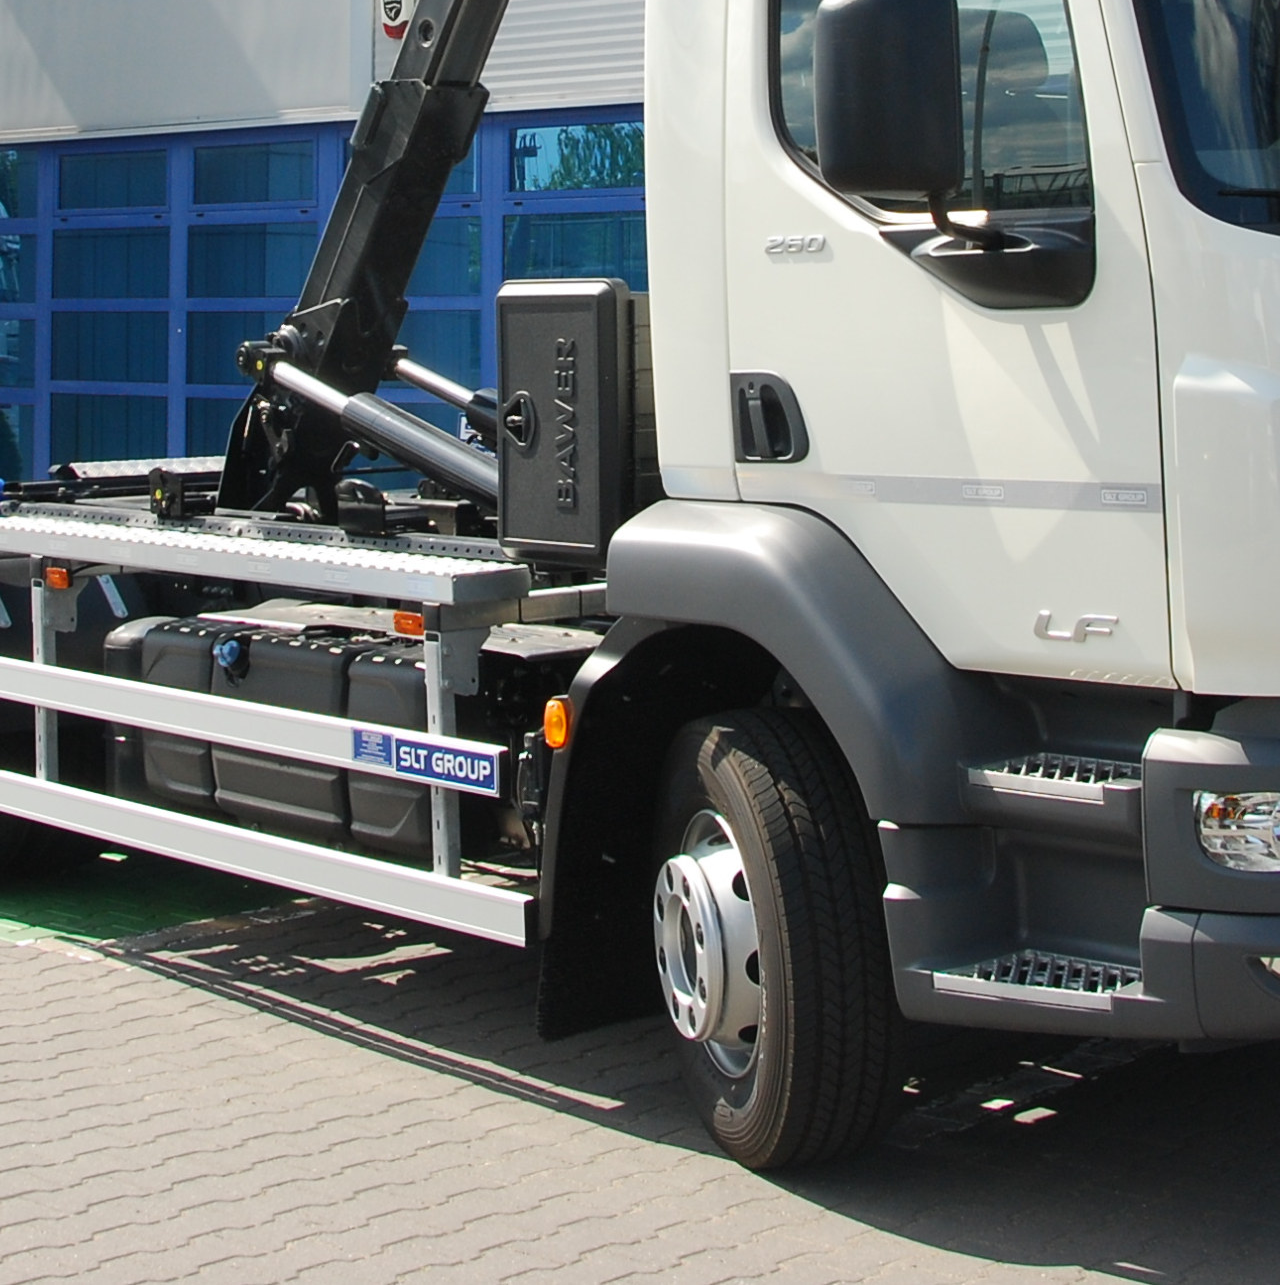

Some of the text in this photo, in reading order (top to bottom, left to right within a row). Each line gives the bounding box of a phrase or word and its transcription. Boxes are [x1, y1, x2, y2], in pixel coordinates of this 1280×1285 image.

[765, 234, 826, 254] 260
[554, 337, 576, 510] BAWER
[1034, 609, 1119, 643] LF
[399, 745, 428, 770] SLT
[431, 752, 491, 781] GROUP
